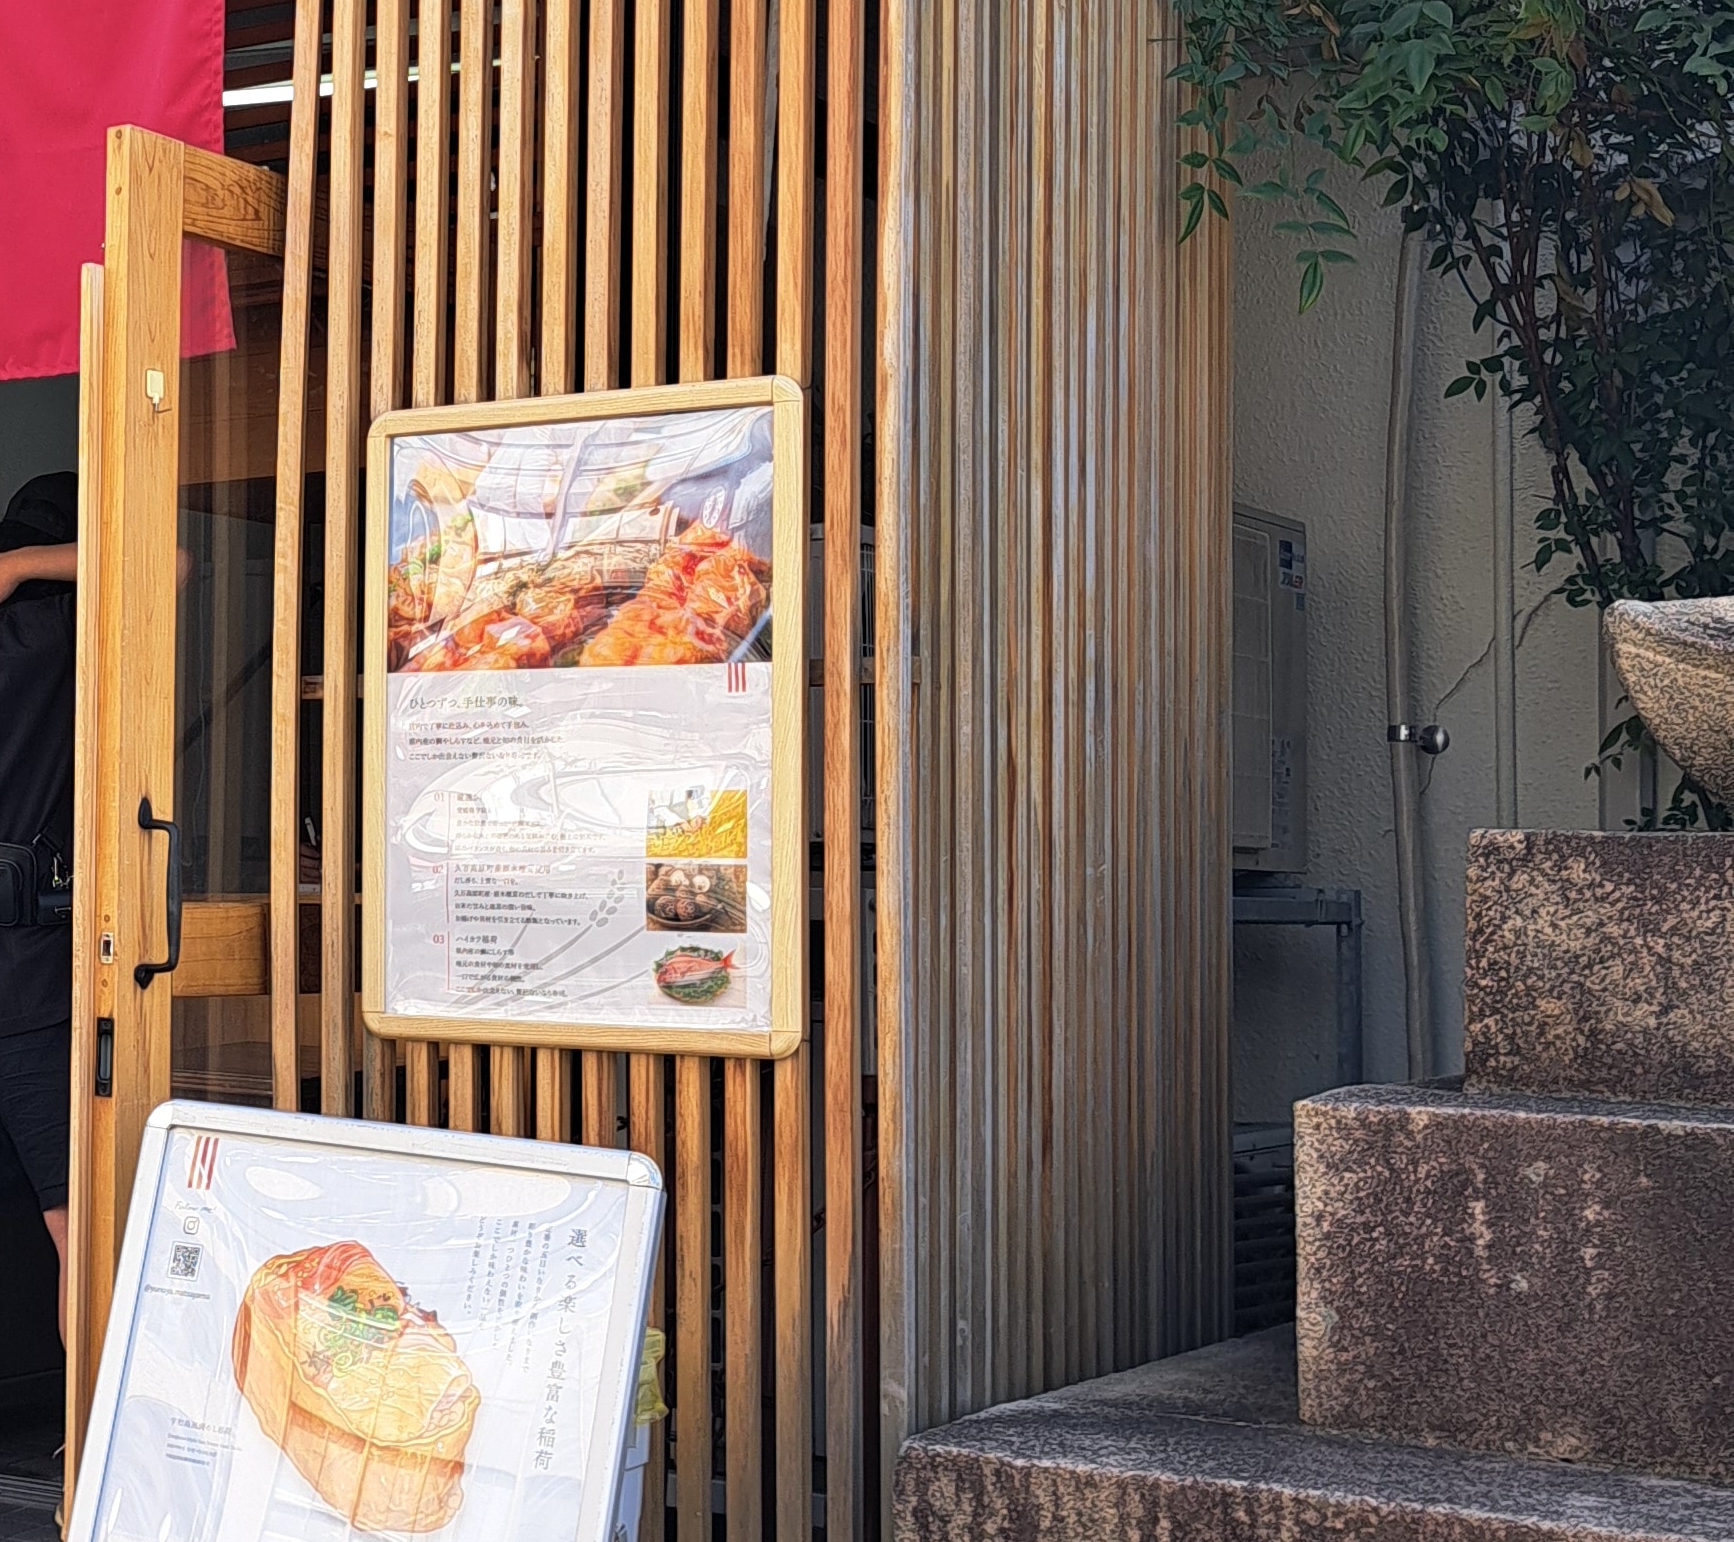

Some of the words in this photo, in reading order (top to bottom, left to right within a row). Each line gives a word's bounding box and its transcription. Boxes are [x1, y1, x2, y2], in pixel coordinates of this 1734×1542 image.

[433, 792, 445, 803] 01
[432, 865, 444, 874] 02
[433, 934, 445, 945] 03
[533, 1227, 588, 1471] 選べる楽しさ豊富な稲荷
